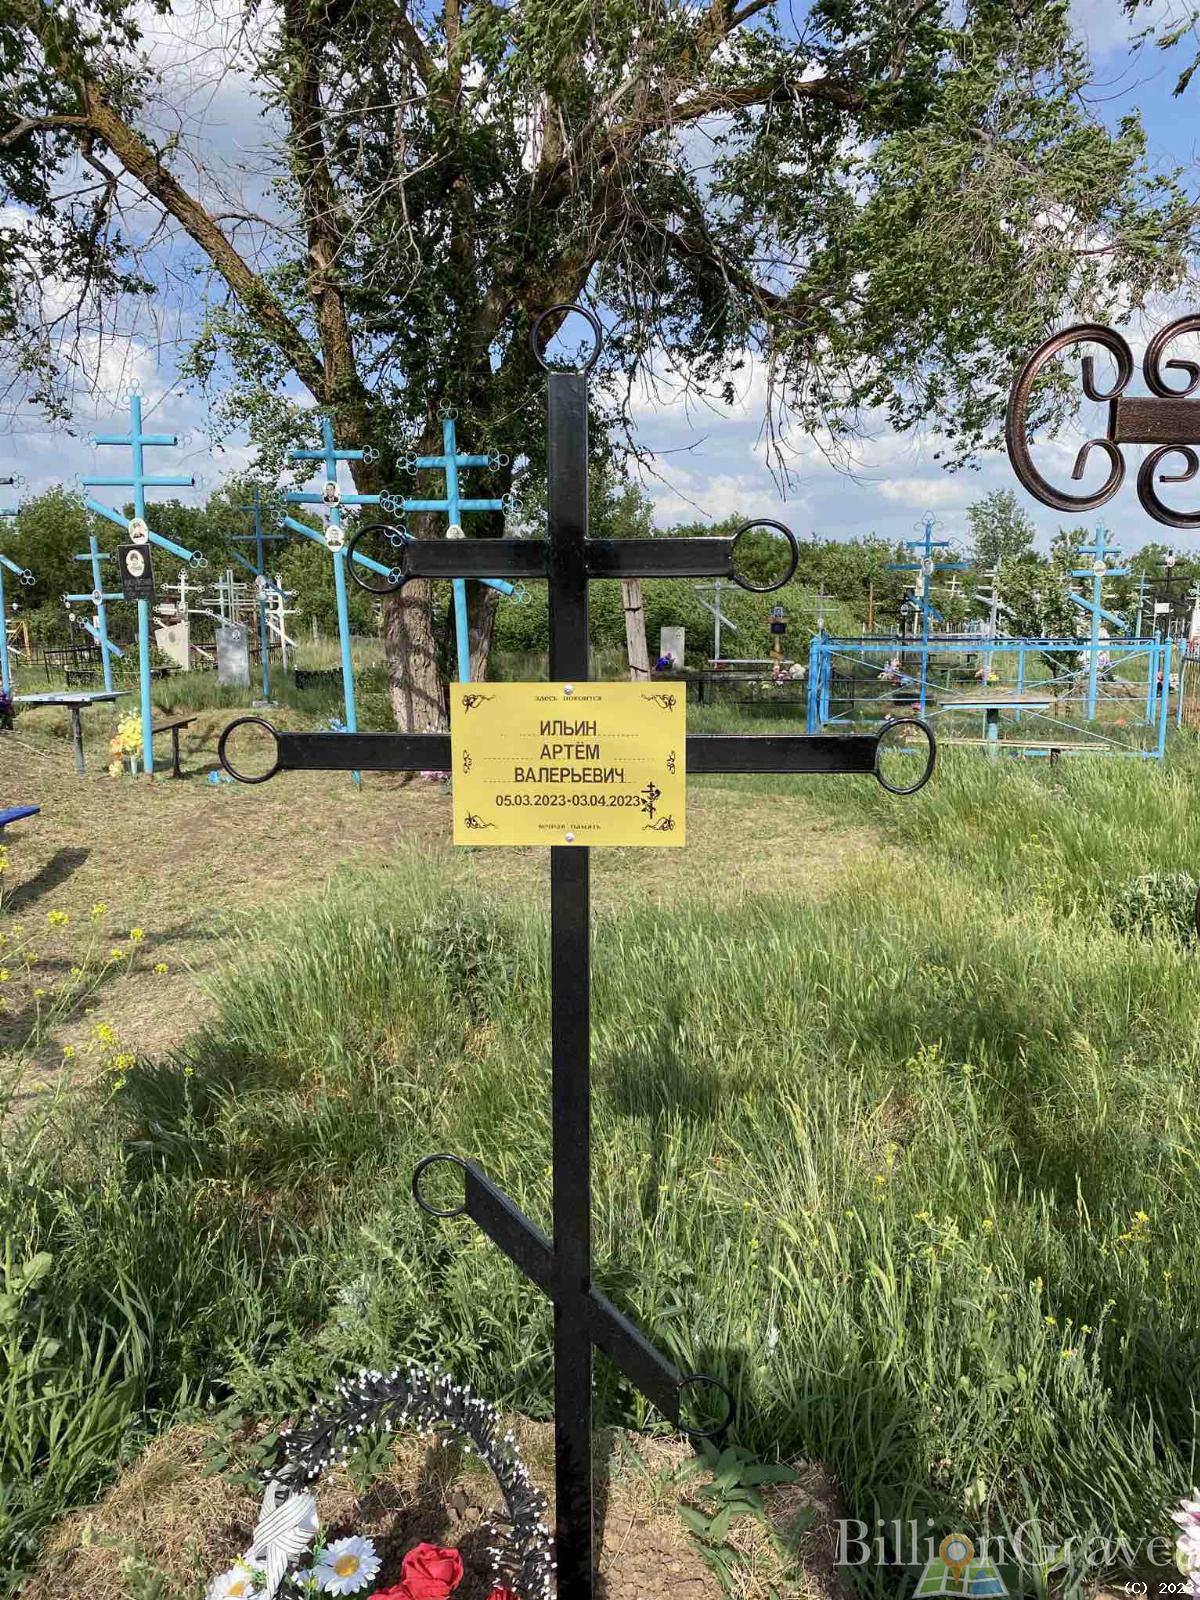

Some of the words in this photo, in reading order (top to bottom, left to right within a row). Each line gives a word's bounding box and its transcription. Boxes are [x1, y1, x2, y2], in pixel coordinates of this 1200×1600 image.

[540, 720, 597, 737] ИЛЬИН
[540, 742, 600, 760] АРТЁМ
[514, 767, 625, 784] ВАЛЕРЬЕВИЧ
[495, 795, 641, 807] 05.03.2023-03.04.2023
